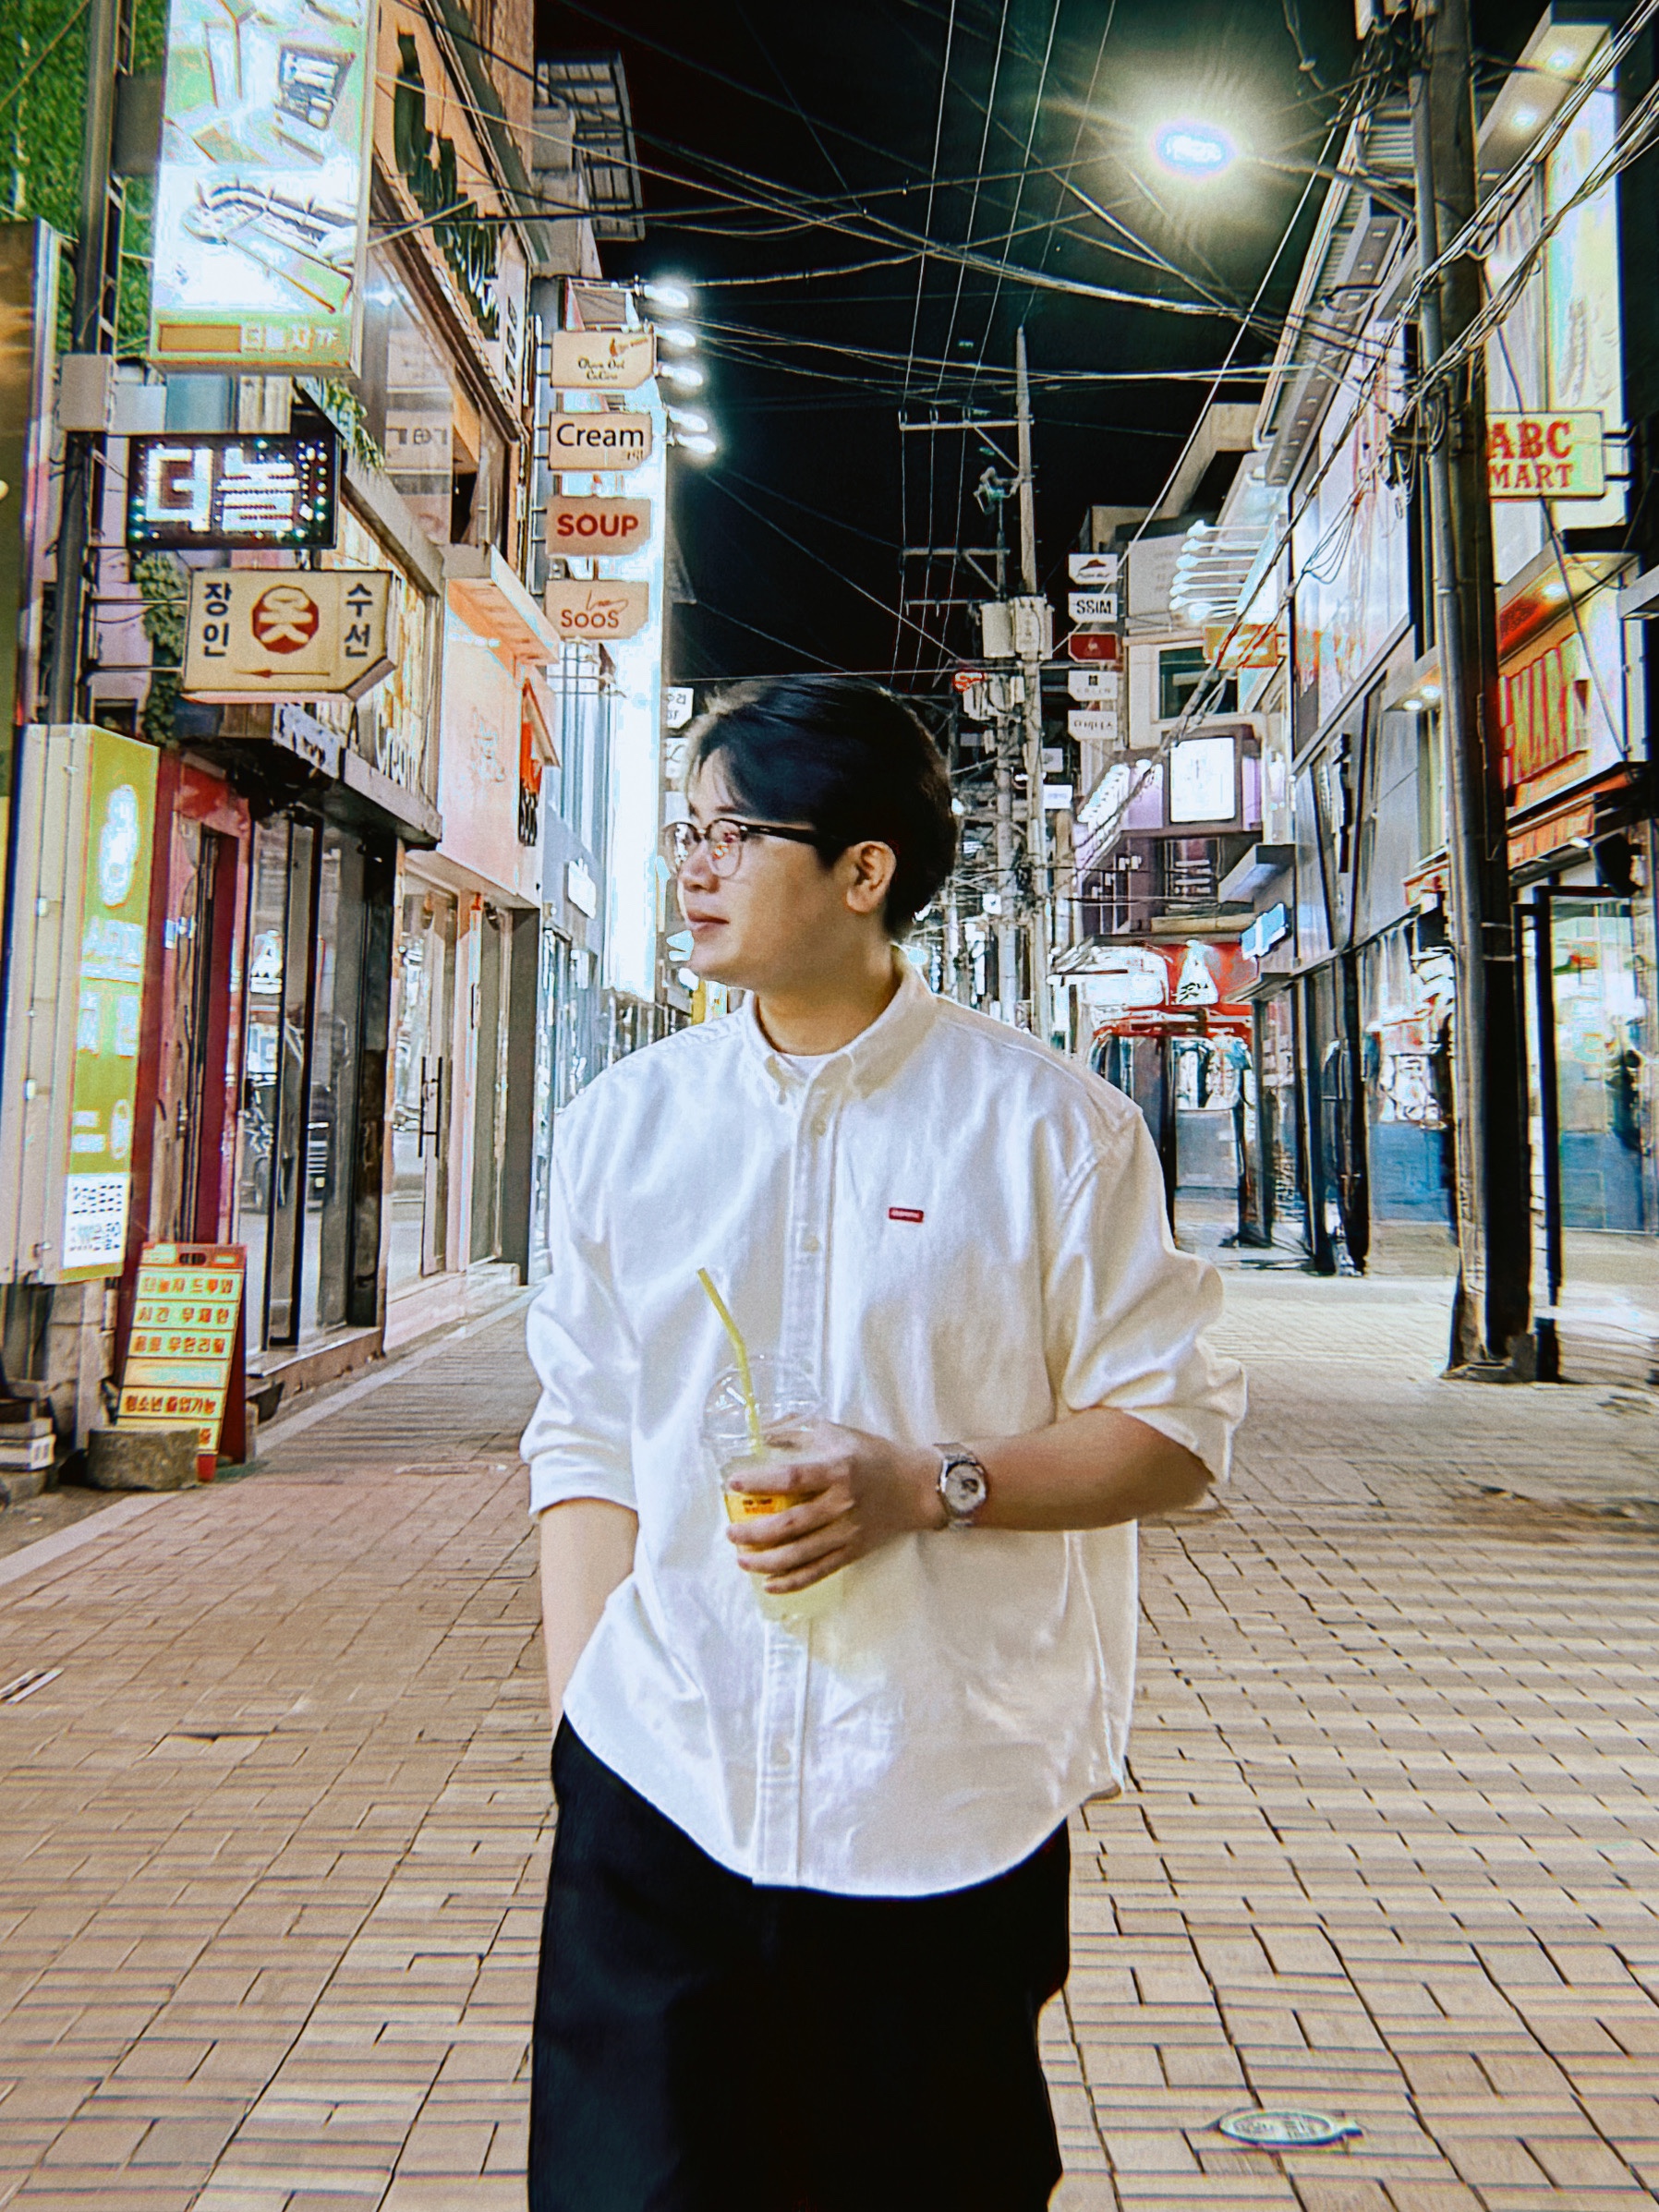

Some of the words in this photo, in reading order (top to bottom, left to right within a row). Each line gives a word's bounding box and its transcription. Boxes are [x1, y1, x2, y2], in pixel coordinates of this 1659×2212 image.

[556, 421, 644, 447] Cream
[1486, 421, 1571, 459] ABC
[1488, 464, 1574, 489] MART
[557, 513, 638, 537] SOUP
[203, 582, 231, 658] 장인
[345, 583, 373, 658] 수선
